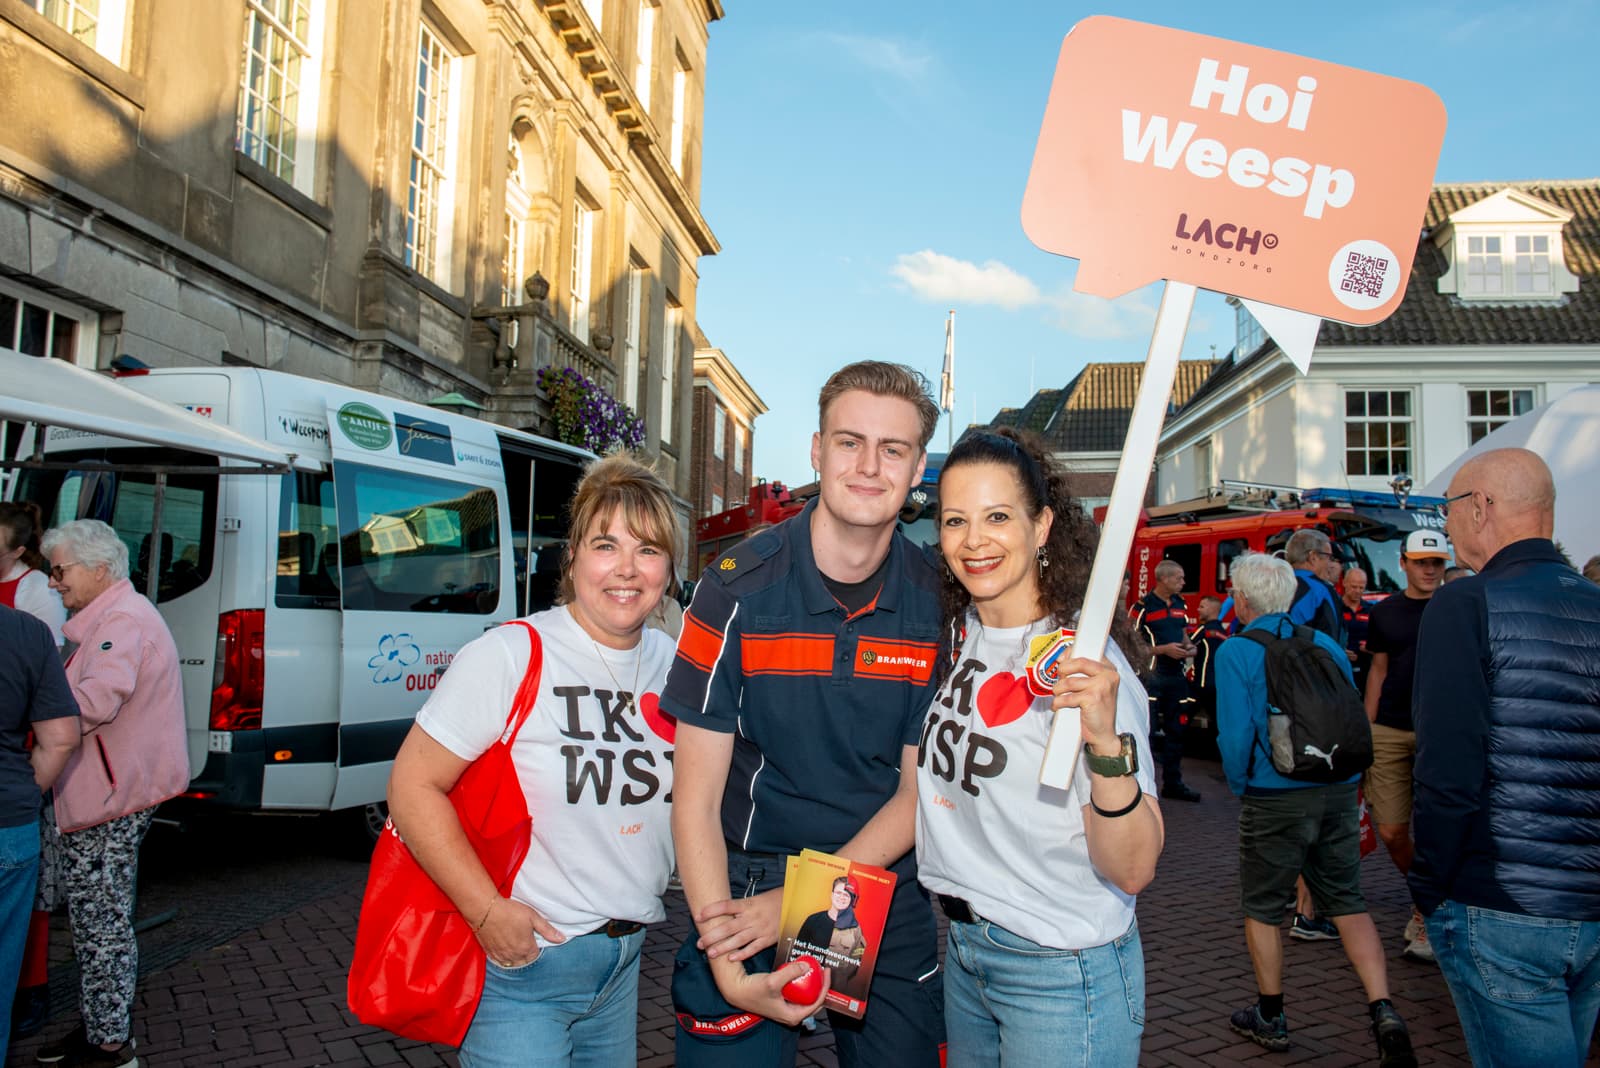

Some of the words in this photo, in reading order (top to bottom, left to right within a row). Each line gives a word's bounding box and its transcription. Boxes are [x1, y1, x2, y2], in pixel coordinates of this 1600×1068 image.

[1189, 57, 1318, 132] Hoi
[1121, 108, 1356, 220] Weesp
[1171, 244, 1272, 273] MONDZORG
[1138, 545, 1150, 599] 13-4532
[425, 650, 456, 665] natio
[877, 655, 928, 669] BRANWEER
[406, 668, 441, 692] oud
[934, 658, 987, 716] K
[553, 685, 645, 742] IK
[560, 745, 674, 806] WS
[793, 939, 807, 949] Het
[807, 942, 861, 967] brandweerwerk
[695, 1015, 752, 1032] BRANDWEER
